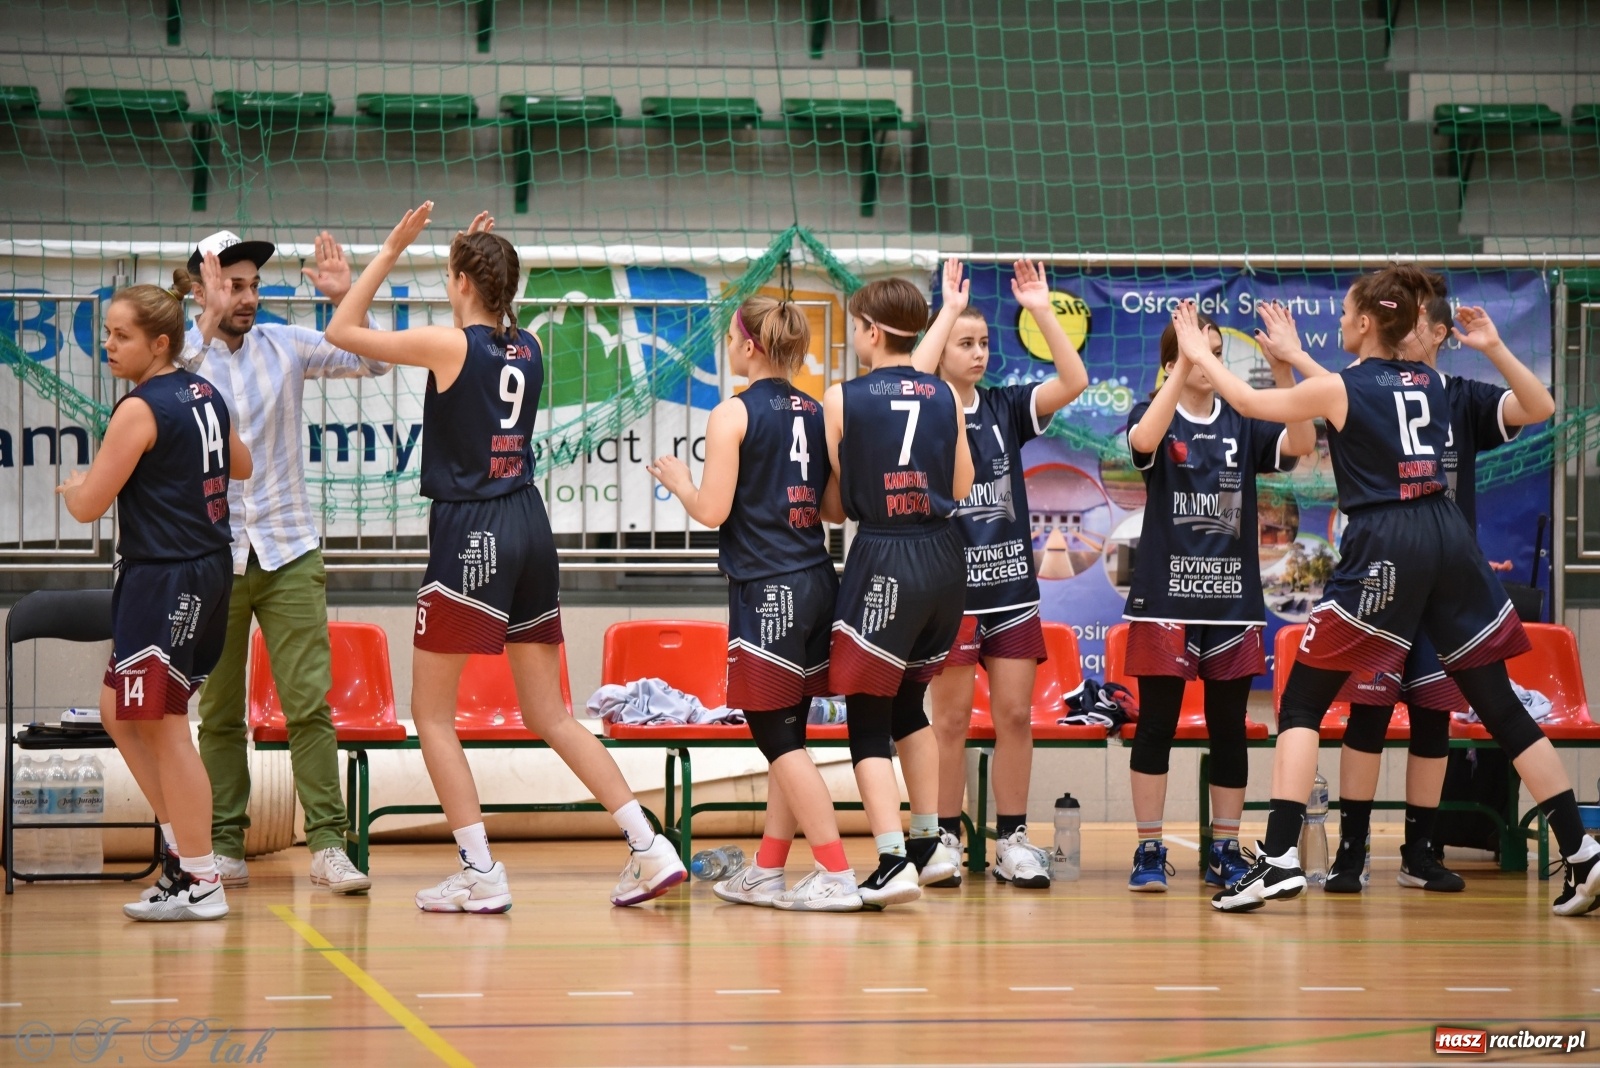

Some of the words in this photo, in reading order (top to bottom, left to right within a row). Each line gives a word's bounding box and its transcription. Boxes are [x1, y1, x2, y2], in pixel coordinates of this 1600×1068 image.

[499, 364, 525, 429] 9
[870, 380, 936, 399] uks2kp
[191, 401, 224, 474] 14
[890, 400, 920, 466] 7
[1393, 391, 1435, 455] 12
[789, 416, 810, 481] 4
[1222, 437, 1238, 468] 2
[886, 492, 930, 517] POLSKA
[489, 537, 497, 567] PASSION
[965, 547, 1004, 563] IVING
[1005, 543, 1025, 557] UP
[1169, 560, 1222, 574] GIVING
[1224, 561, 1242, 574] UP
[1168, 578, 1243, 594] SUCCEED
[417, 607, 427, 635] 9
[786, 591, 794, 621] PASSION
[124, 676, 144, 707] 14
